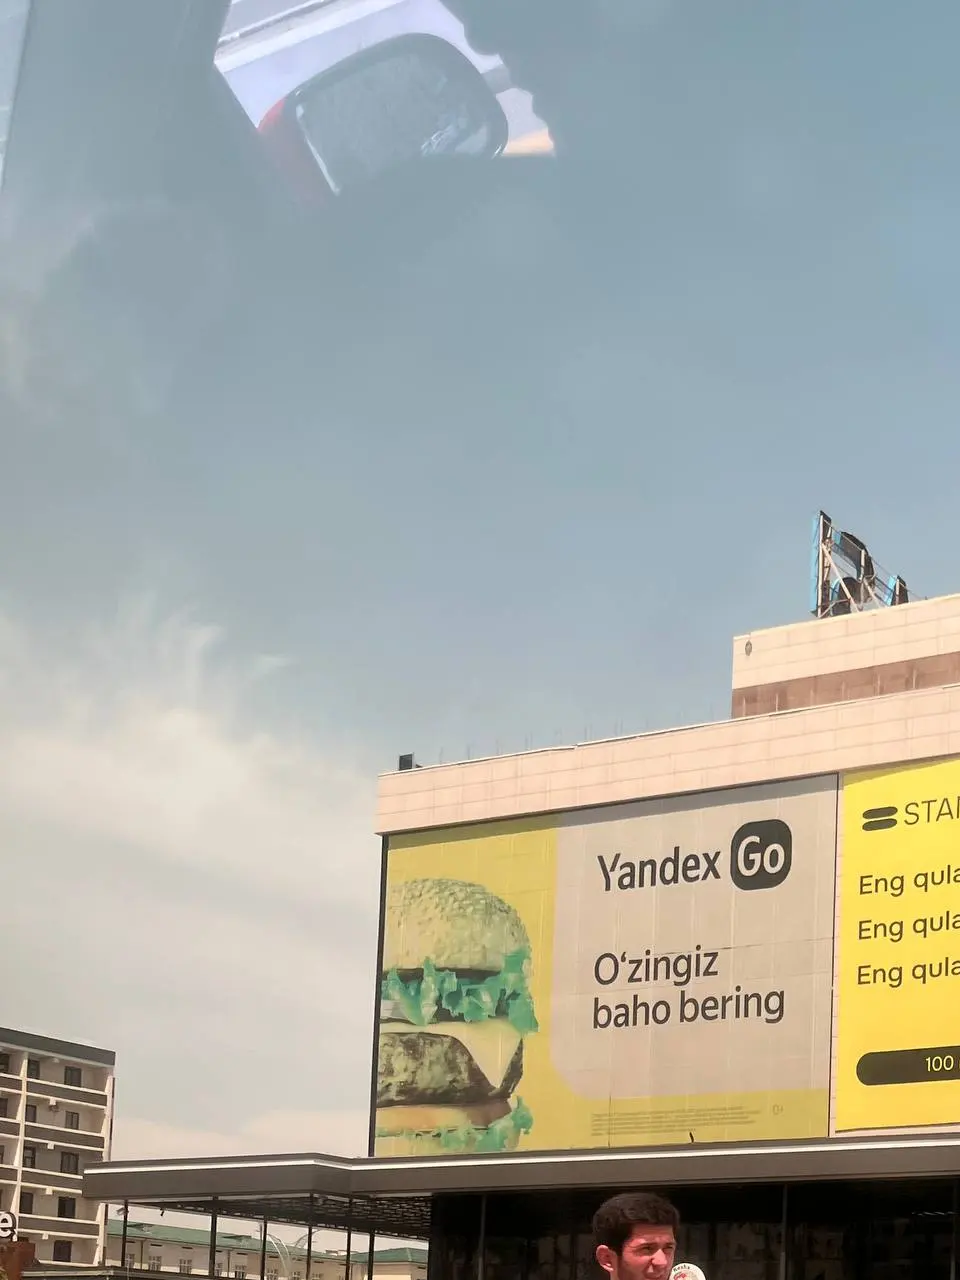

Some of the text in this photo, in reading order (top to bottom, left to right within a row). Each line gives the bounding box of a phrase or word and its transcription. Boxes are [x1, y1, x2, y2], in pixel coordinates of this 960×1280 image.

[597, 834, 786, 892] Yandex Go
[859, 874, 905, 897] Eng
[858, 919, 904, 943] Eng
[857, 964, 903, 988] Eng
[593, 985, 785, 1029] baho bering
[925, 1055, 954, 1072] 100
